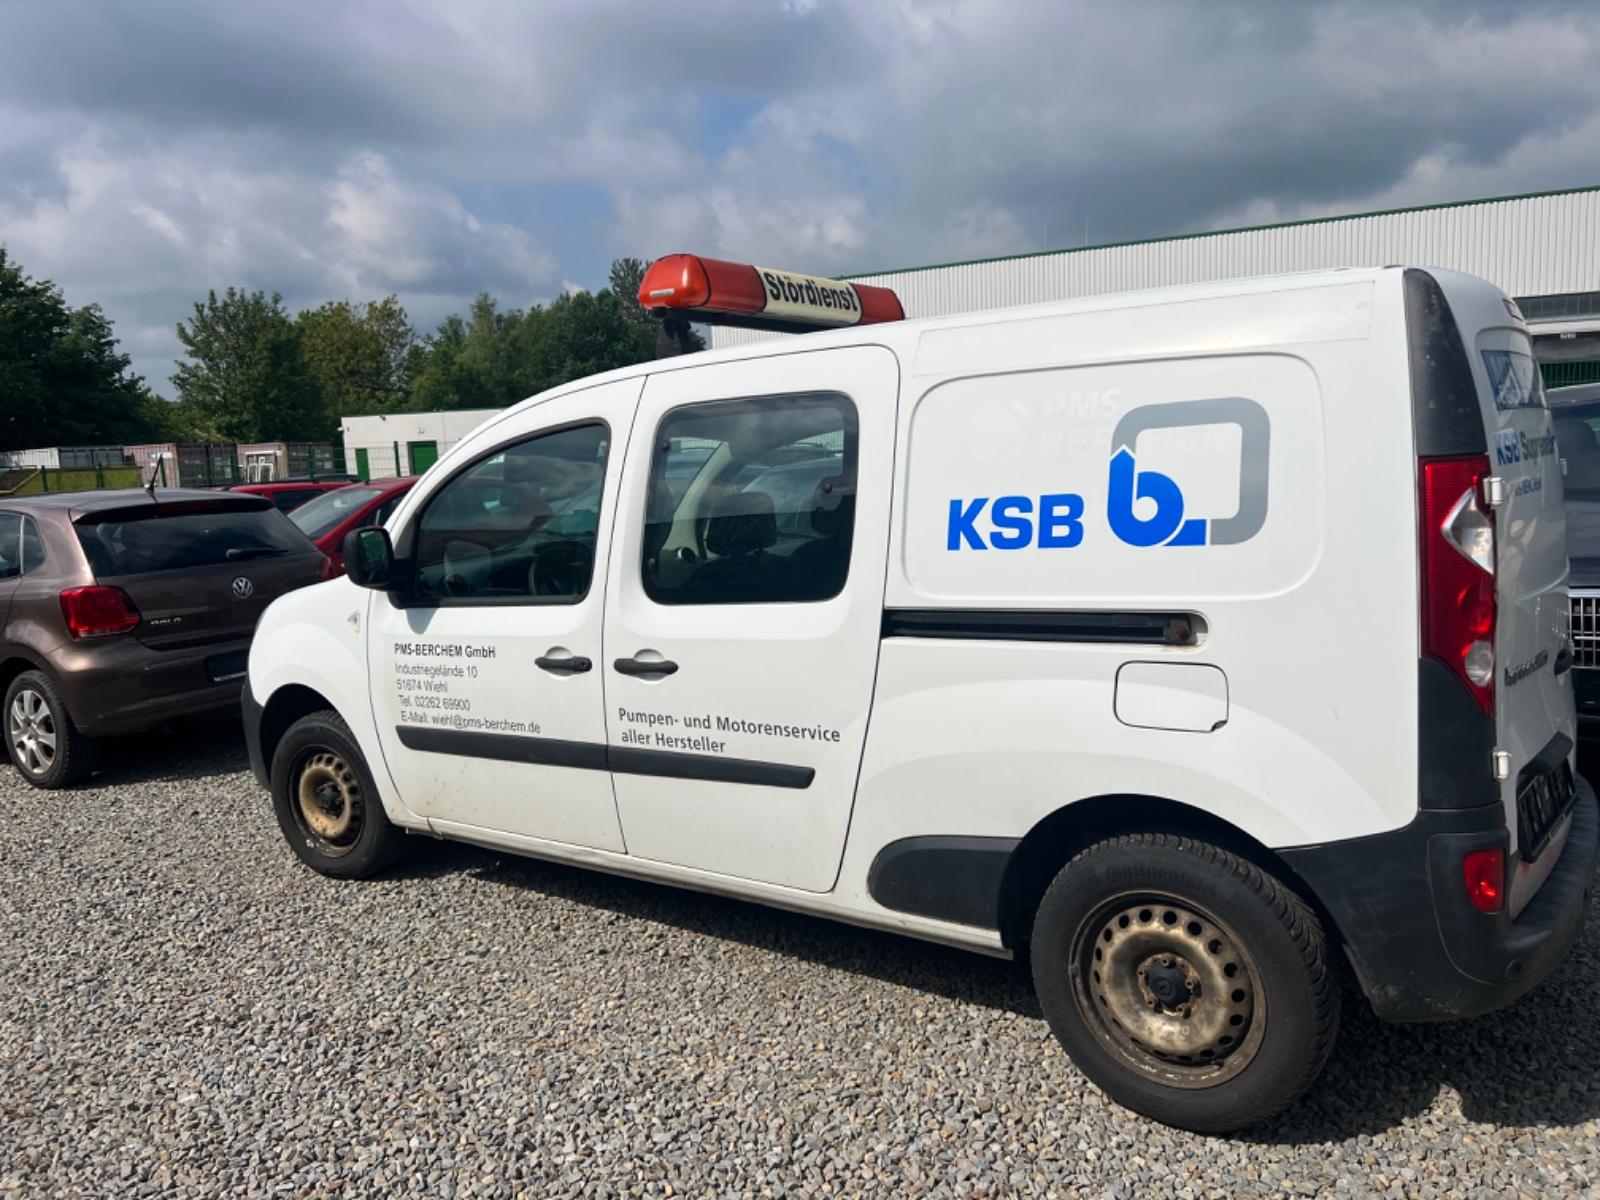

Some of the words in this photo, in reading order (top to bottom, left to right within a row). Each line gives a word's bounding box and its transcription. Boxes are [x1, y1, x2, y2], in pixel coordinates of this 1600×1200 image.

[763, 272, 858, 311] Stördienst
[947, 493, 1085, 551] KSB
[394, 642, 463, 657] PMS-BERCHEM
[464, 645, 497, 659] GmbH
[395, 663, 464, 678] Industriegelände
[466, 665, 478, 678] 10
[423, 680, 448, 693] Wiehl
[414, 696, 441, 709] 02262
[431, 713, 541, 734] wiehl@pms-berchem.de
[618, 707, 679, 728] Pumpen-
[683, 714, 712, 730] und
[716, 716, 841, 742] Motorenservice
[621, 729, 651, 746] aller
[655, 732, 726, 753] Hersteller
